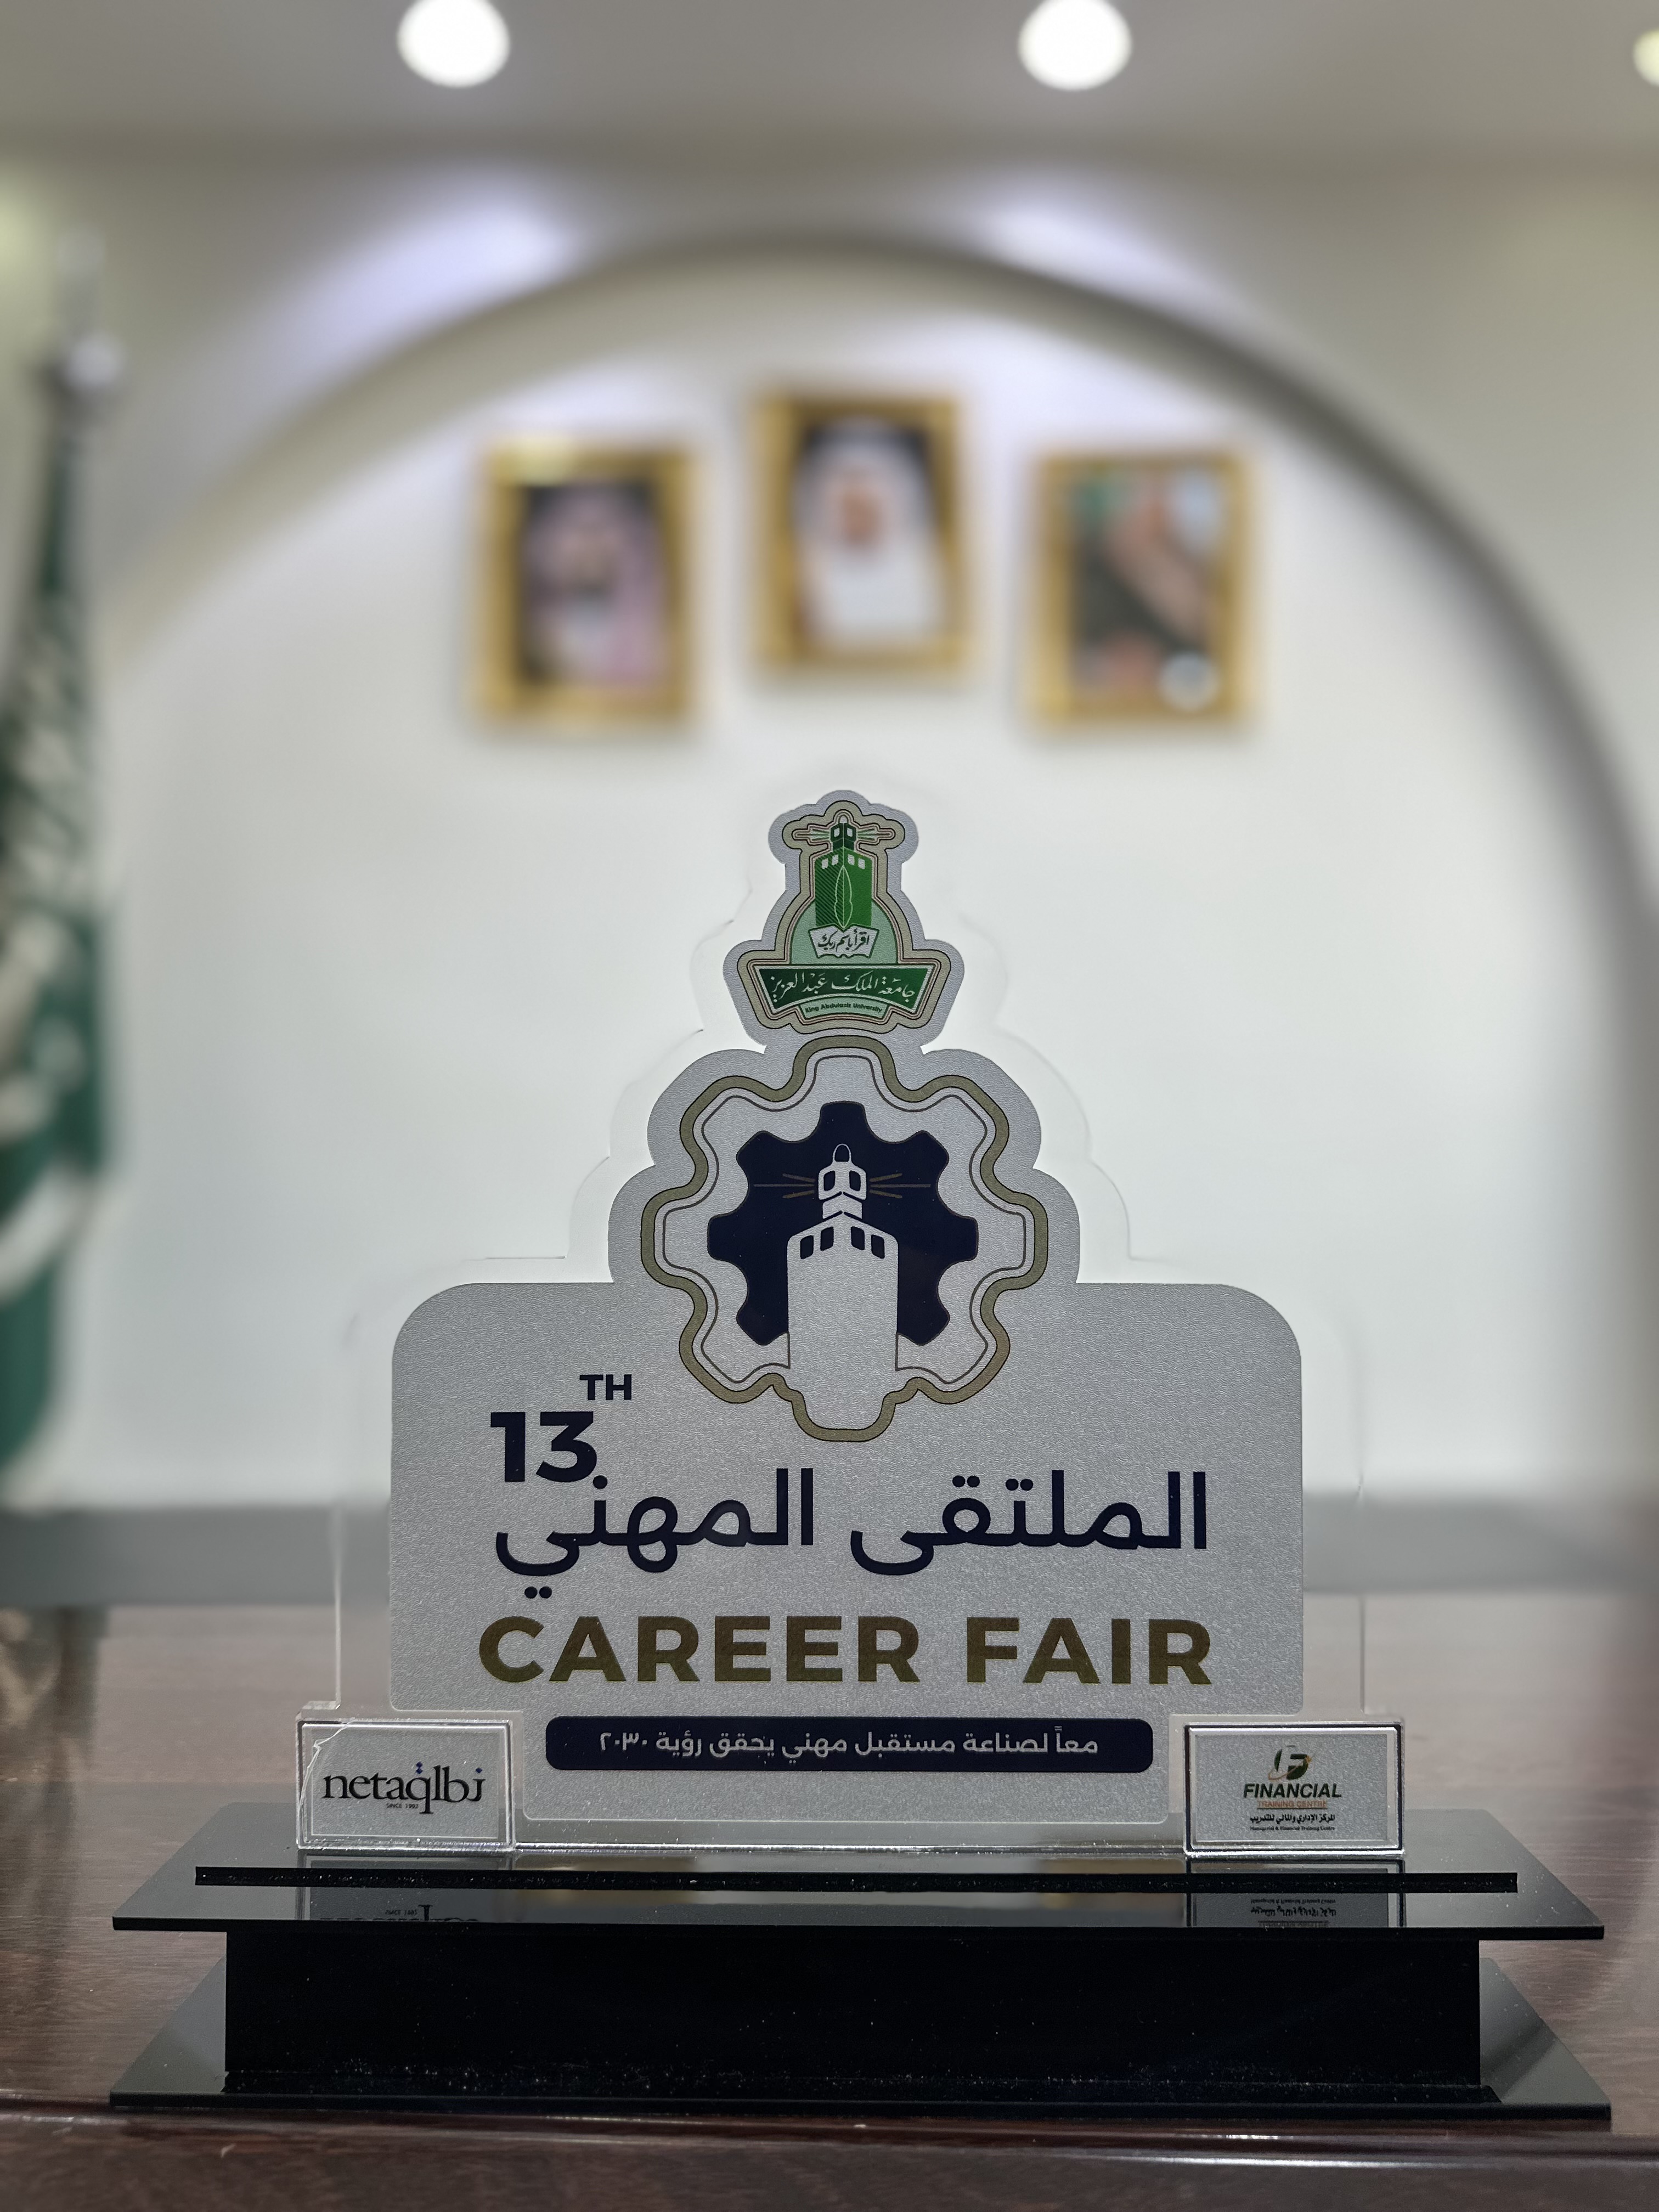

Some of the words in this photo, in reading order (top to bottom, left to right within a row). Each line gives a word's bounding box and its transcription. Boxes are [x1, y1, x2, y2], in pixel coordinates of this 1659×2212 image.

[831, 969, 879, 992] الملك
[853, 1002, 883, 1014] University
[490, 1410, 597, 1482] 13
[579, 1374, 632, 1401] TH
[495, 1468, 814, 1599] المهني
[850, 1469, 1206, 1576] الملتقى
[478, 1615, 921, 1683] CAREER
[966, 1617, 1212, 1686] FAIR
[599, 1731, 648, 1751] ٢٠٣٠
[656, 1729, 702, 1757] رؤية
[709, 1732, 775, 1758] يحقق
[781, 1732, 848, 1764] مهني
[854, 1731, 956, 1758] مستقبل
[962, 1731, 1048, 1753] لصناعة
[1243, 1783, 1342, 1798] FINANCIAL
[1296, 1800, 1327, 1808] CENTRE
[1249, 1813, 1276, 1824] للتدريب
[1318, 1813, 1335, 1823] المركز
